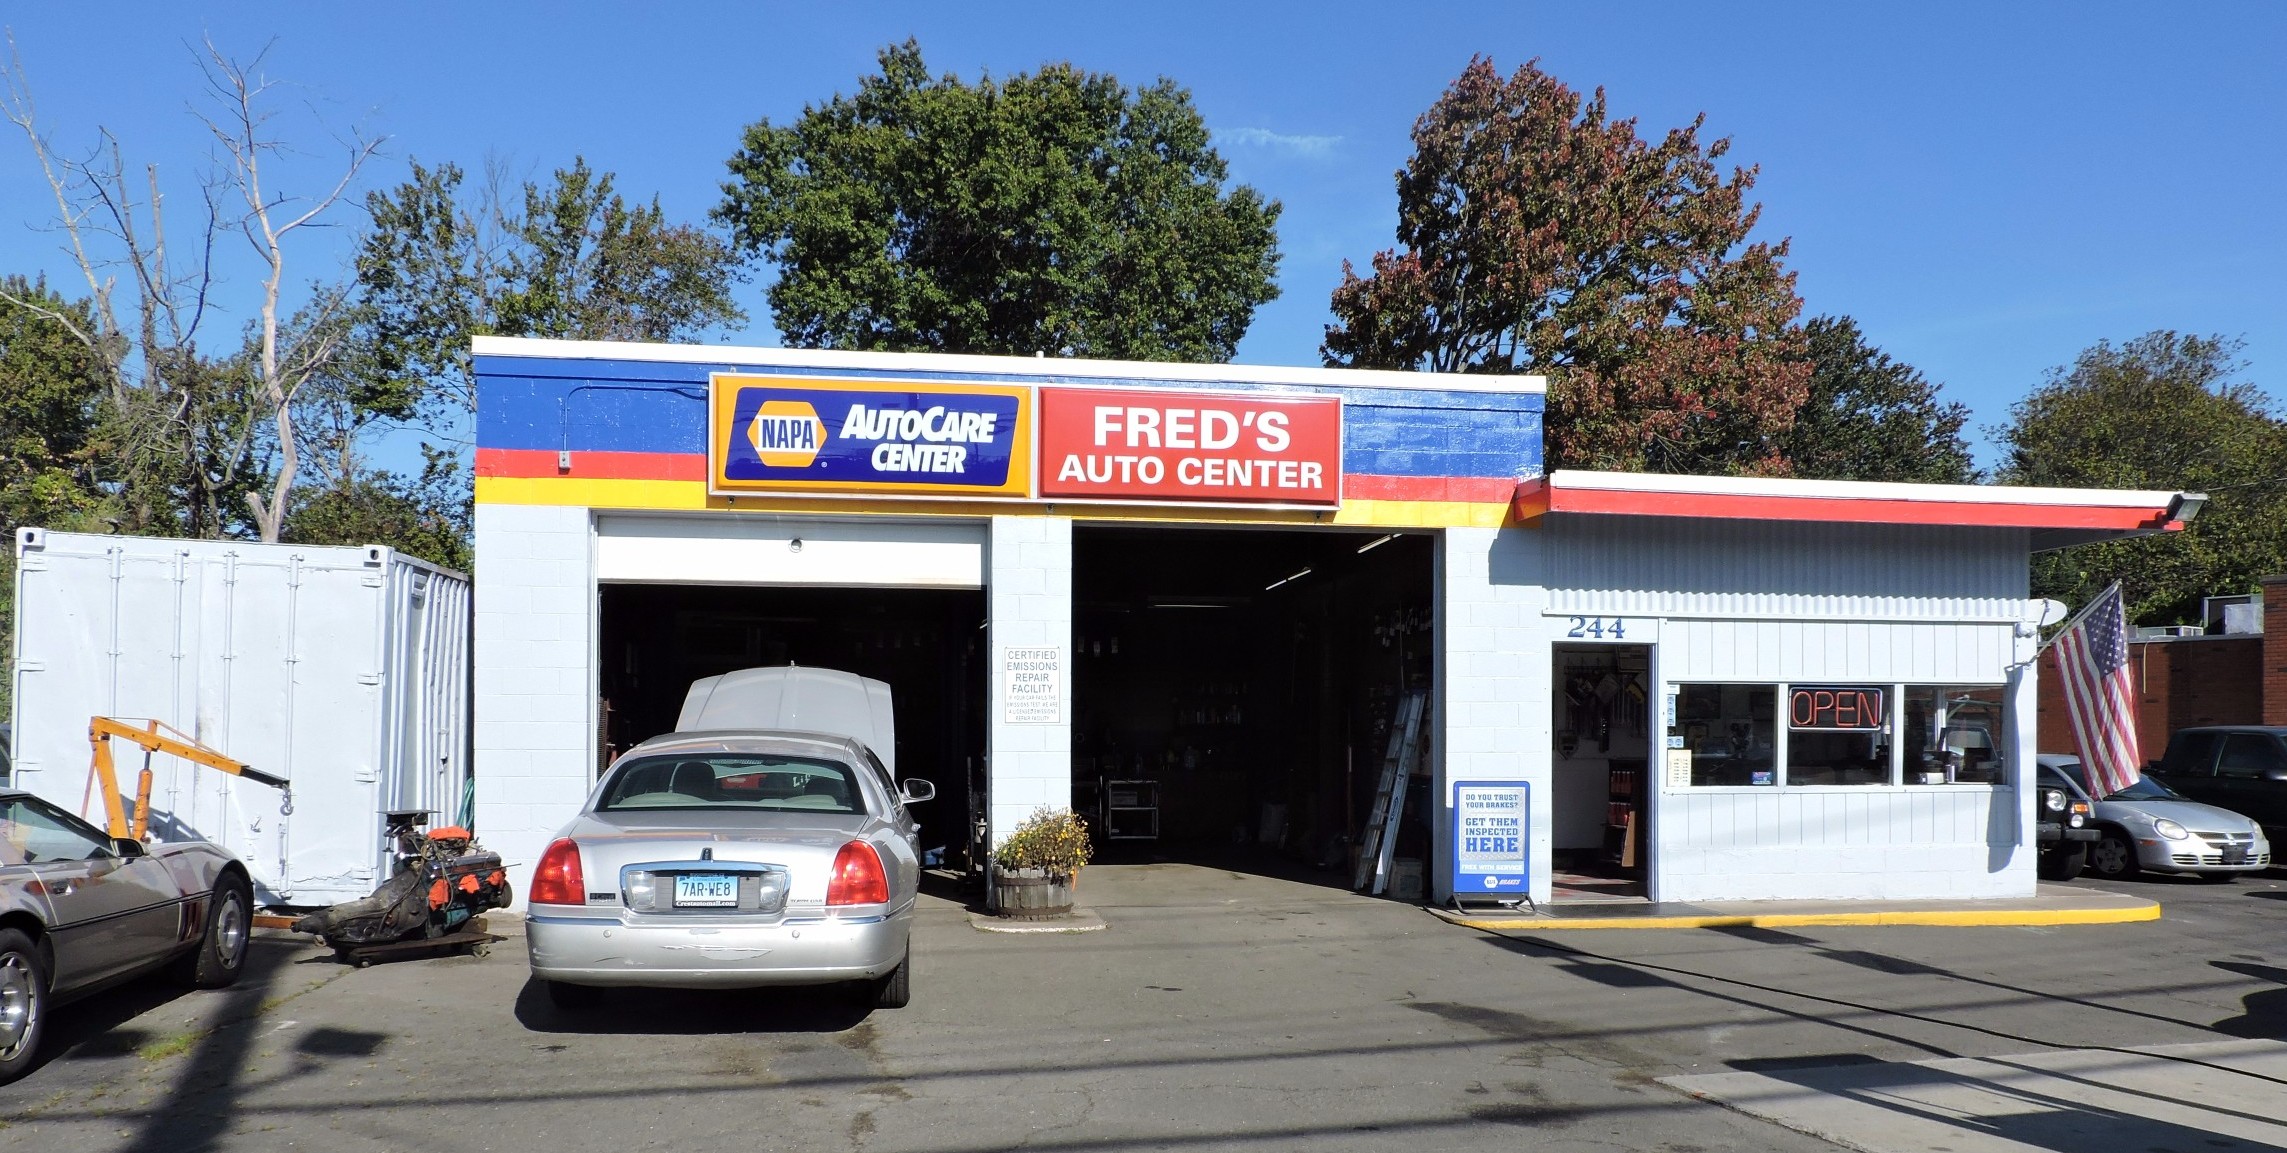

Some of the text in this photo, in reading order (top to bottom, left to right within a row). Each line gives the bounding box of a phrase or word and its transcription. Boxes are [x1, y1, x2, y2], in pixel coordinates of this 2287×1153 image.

[762, 418, 814, 449] NAPA
[1093, 405, 1291, 452] FRED'S
[871, 442, 967, 474] CENTER
[1057, 454, 1323, 489] AUTO CENTER
[1567, 615, 1627, 639] 244
[1007, 650, 1057, 660] CERTIFIED
[1006, 661, 1058, 671] EMISSIONS
[1015, 672, 1050, 682] REPAIR
[1012, 684, 1053, 694] FACILITY
[1792, 691, 1879, 727] OPEN
[1465, 817, 1519, 826] GET THEM
[1465, 827, 1519, 836] INSPECTED
[1465, 837, 1519, 852] HERE
